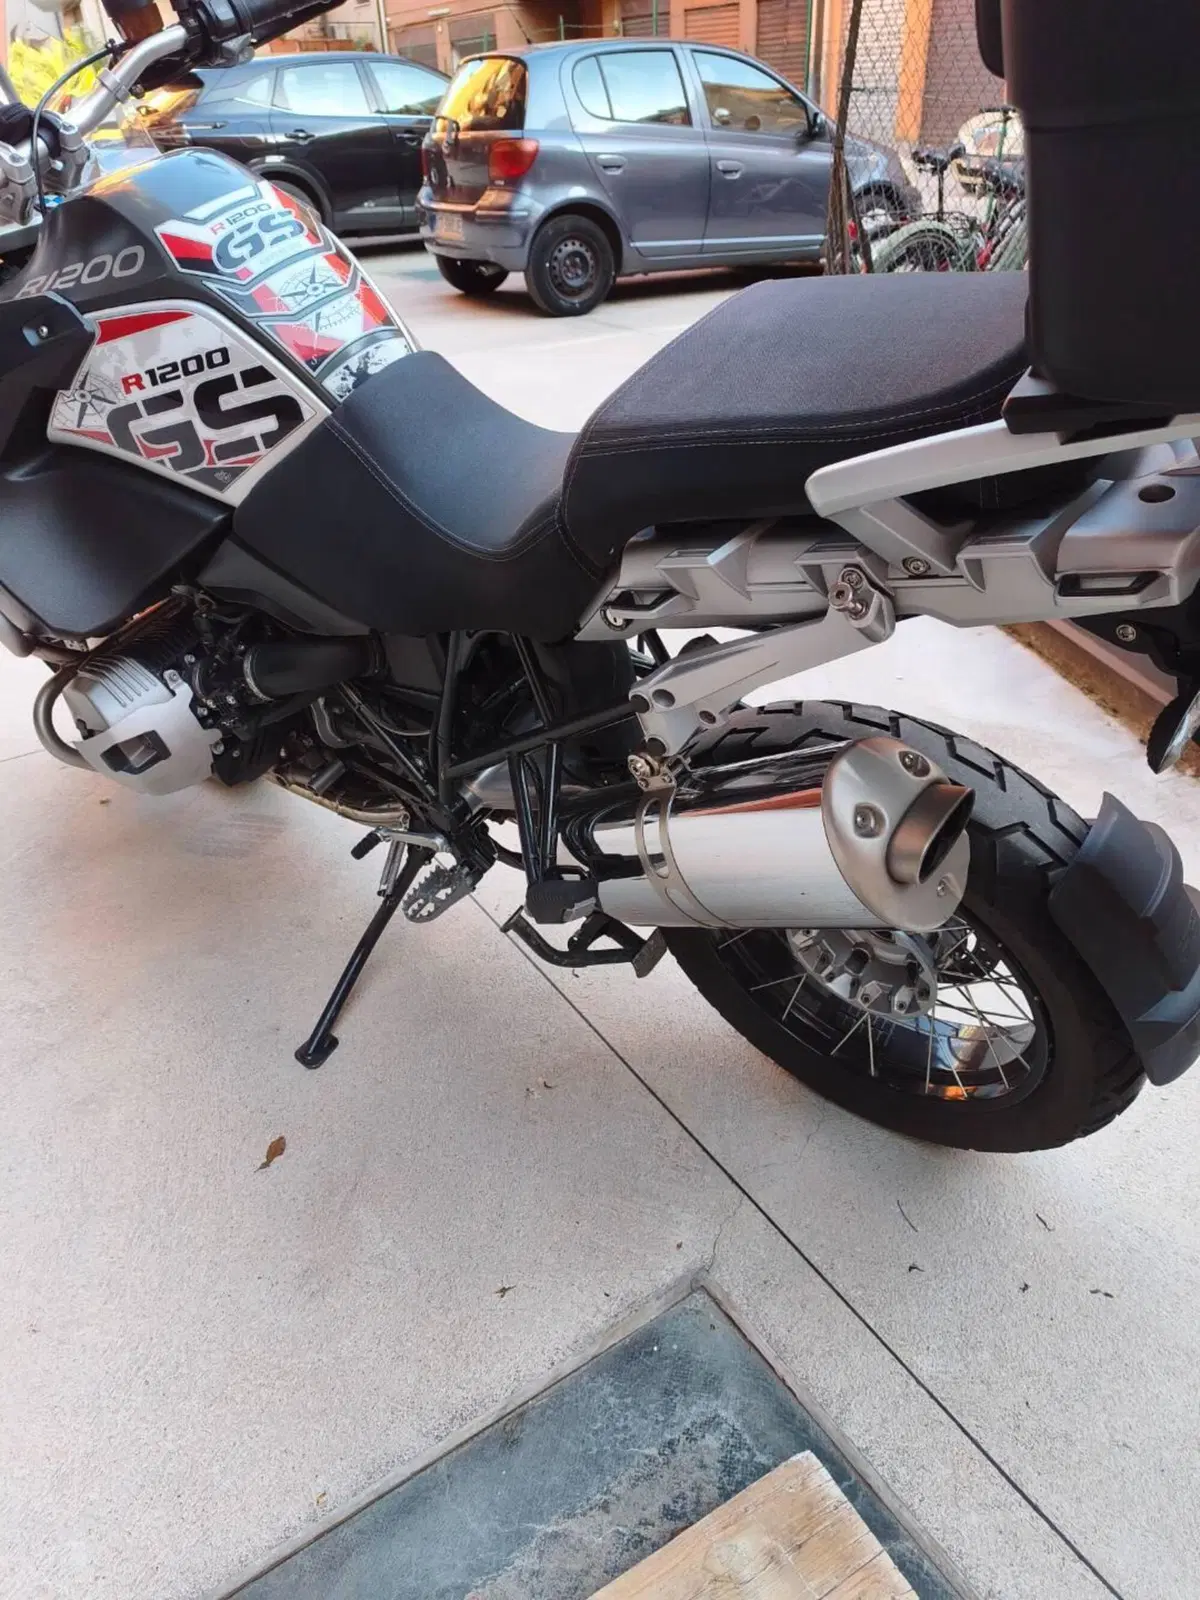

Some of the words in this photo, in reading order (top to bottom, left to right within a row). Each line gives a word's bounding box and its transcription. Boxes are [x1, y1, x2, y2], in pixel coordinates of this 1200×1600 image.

[216, 210, 305, 269] GS
[14, 245, 145, 300] R1200
[106, 365, 306, 471] GS
